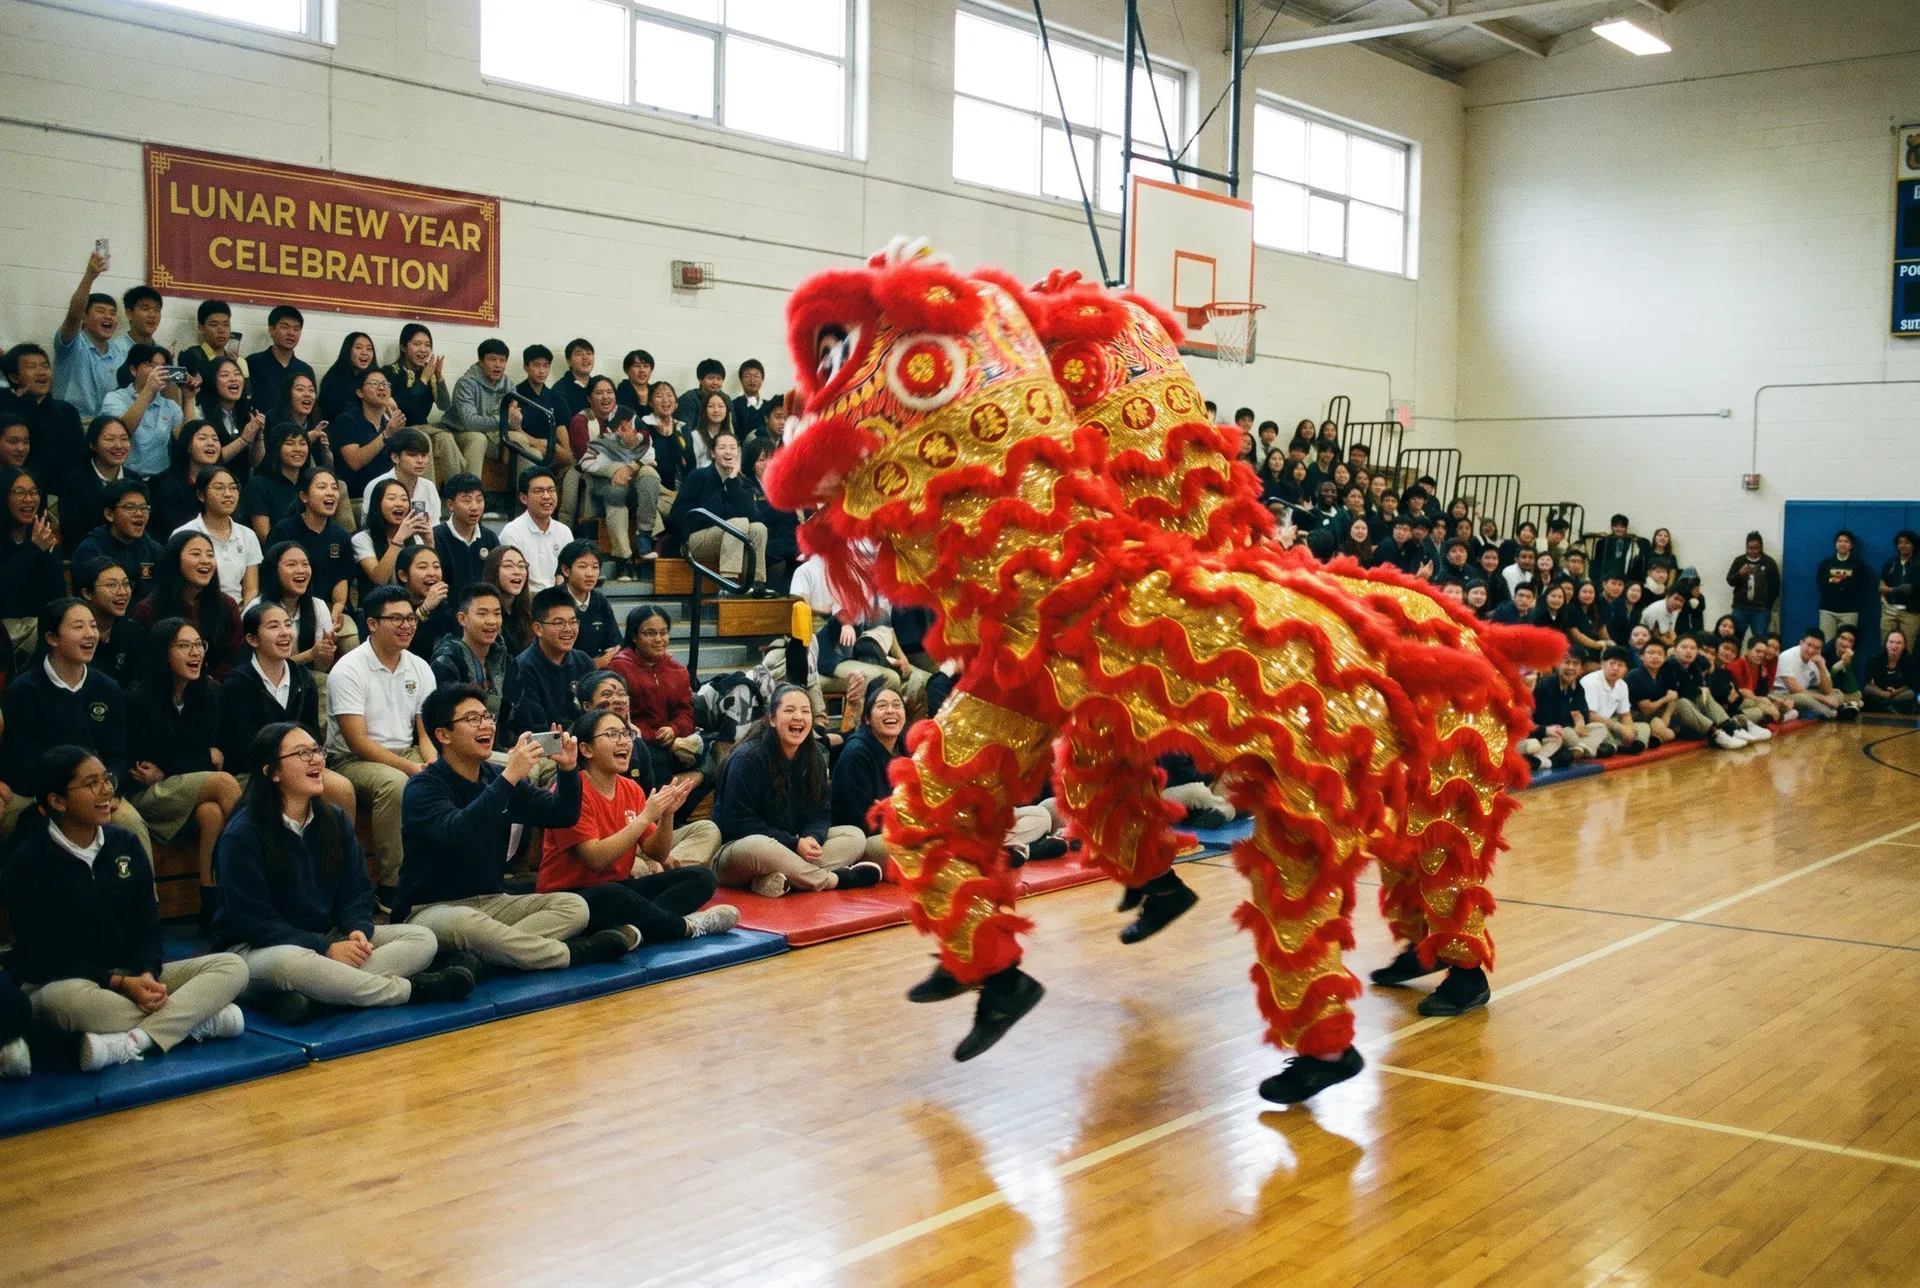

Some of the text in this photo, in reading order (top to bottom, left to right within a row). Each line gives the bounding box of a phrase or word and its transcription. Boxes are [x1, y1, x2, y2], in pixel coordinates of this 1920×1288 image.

[170, 181, 482, 253] LUNAR NEW YEAR
[208, 236, 449, 293] CELEBRATION
